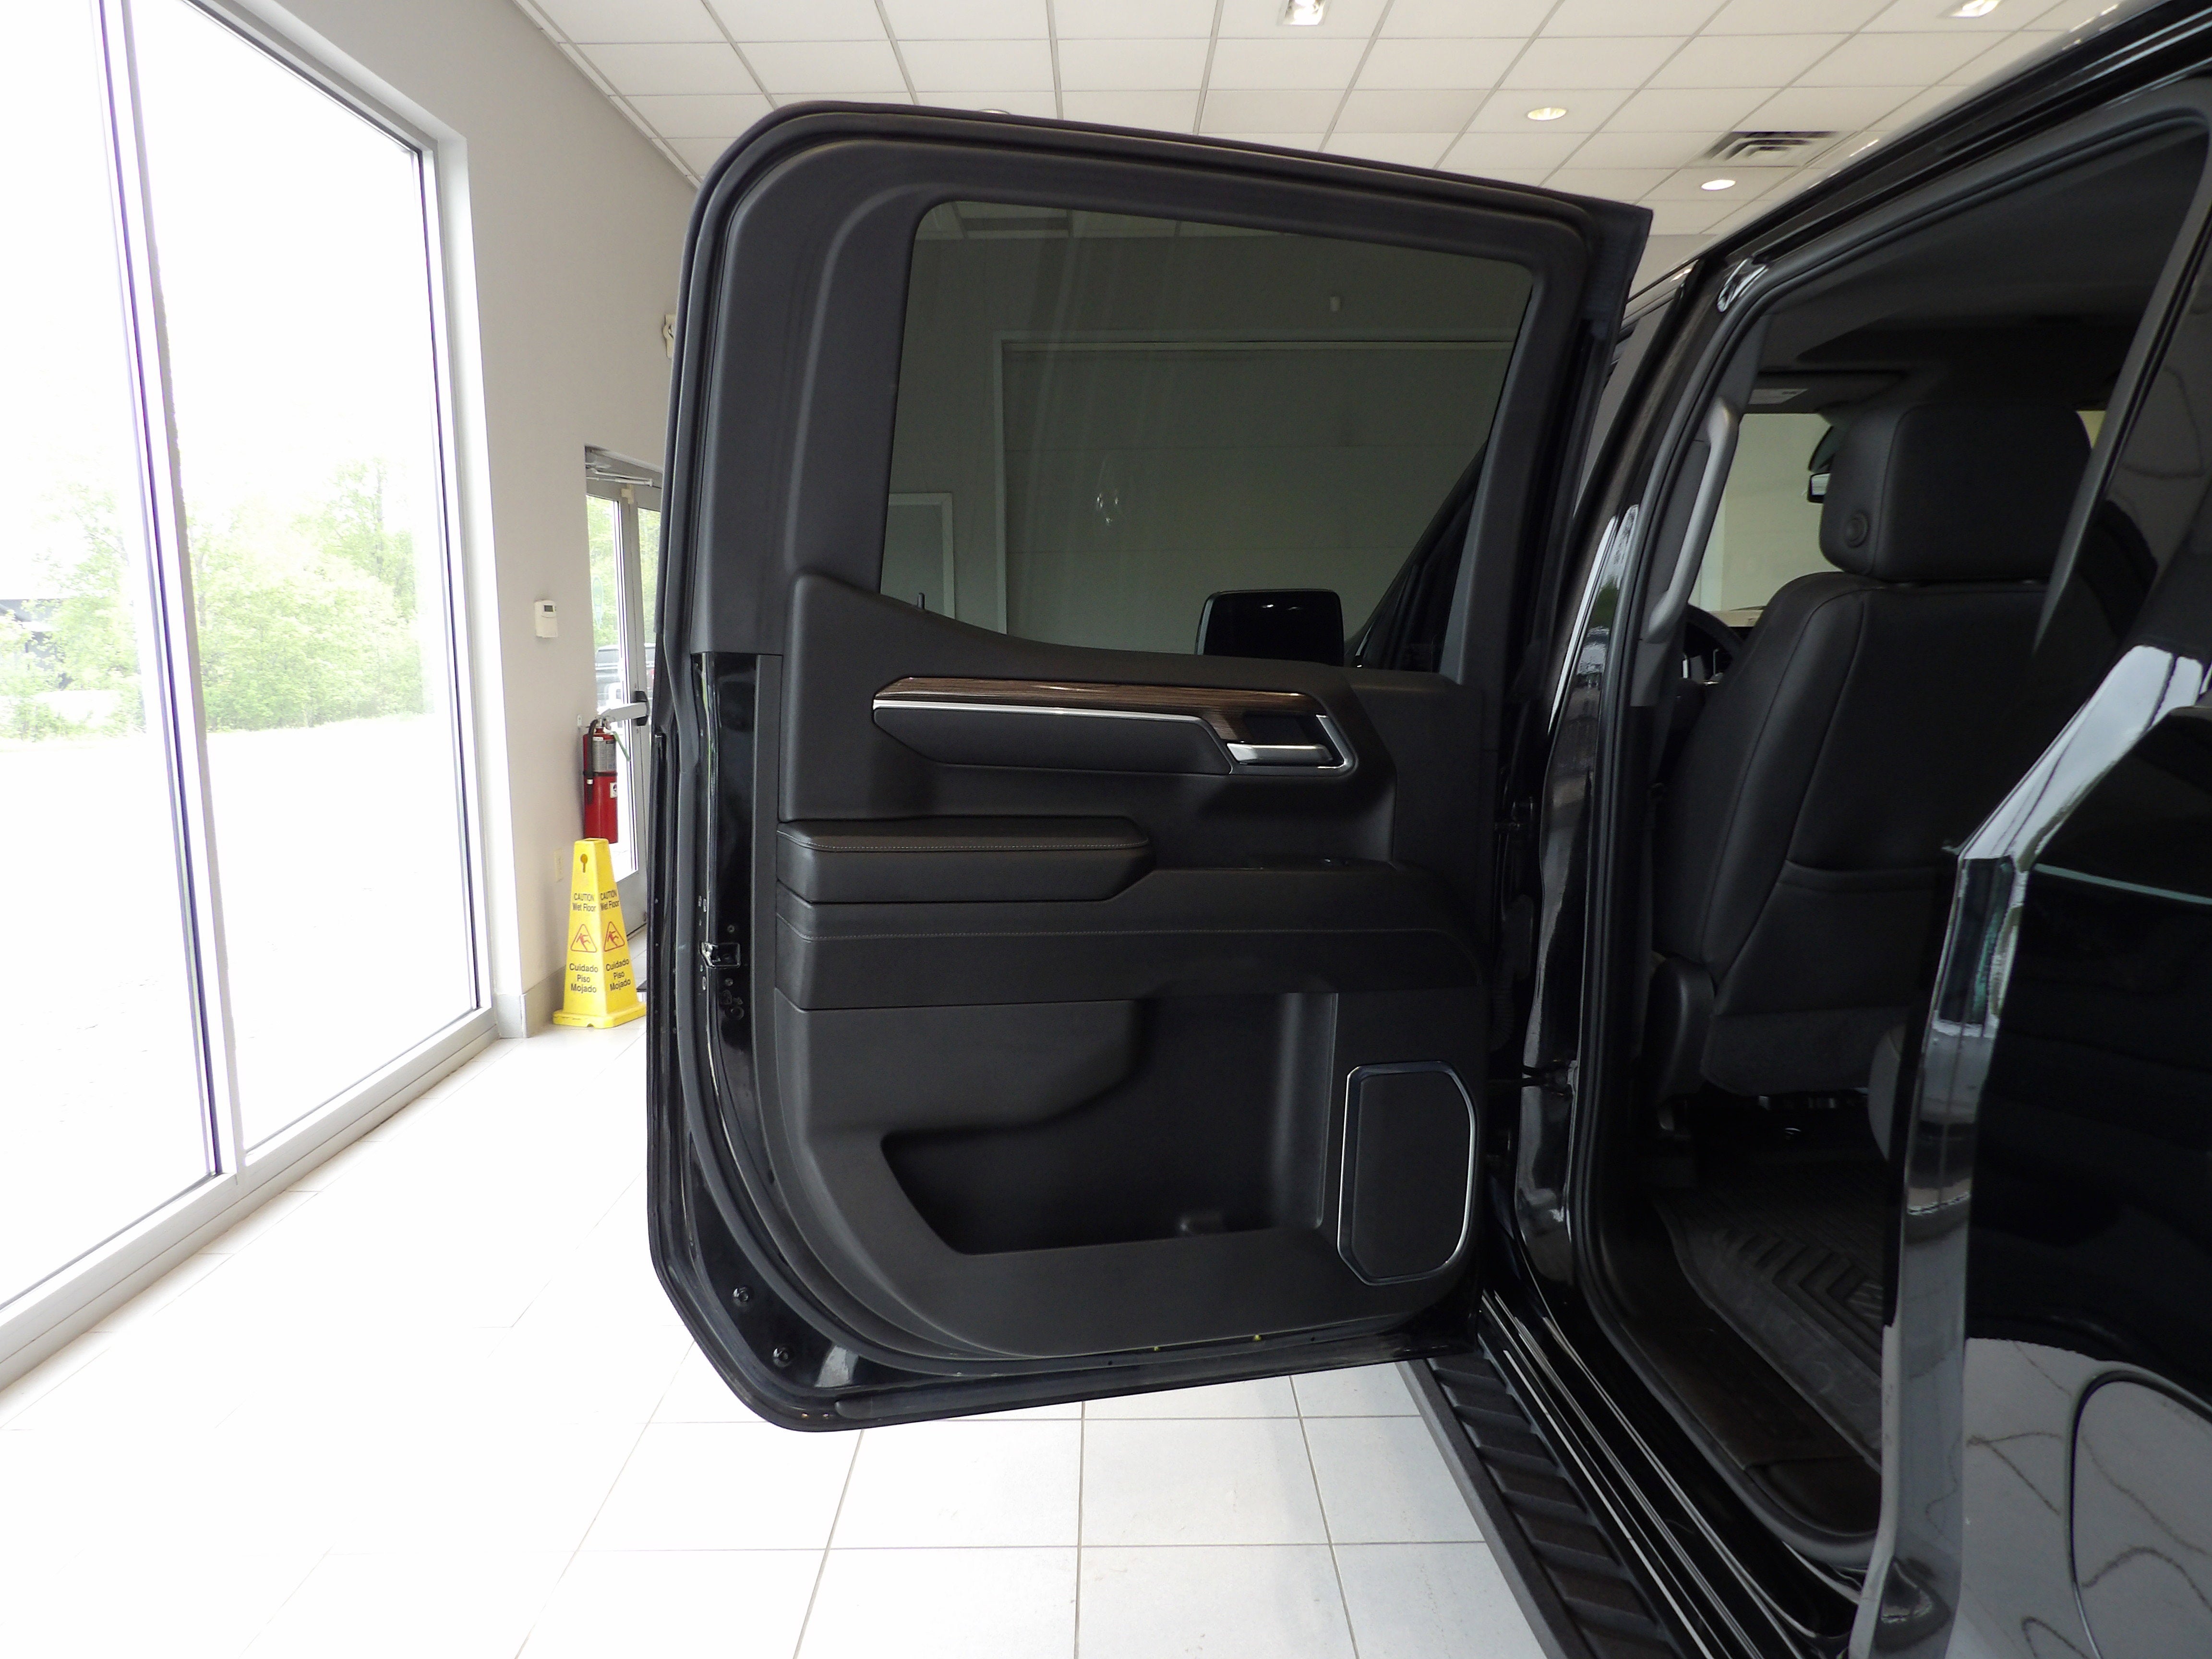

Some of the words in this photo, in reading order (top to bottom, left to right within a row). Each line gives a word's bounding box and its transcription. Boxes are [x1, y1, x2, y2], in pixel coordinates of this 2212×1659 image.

[574, 893, 594, 902] CAUTION
[600, 889, 617, 901] CAUTION
[572, 902, 582, 911] Wet
[583, 903, 596, 912] Floor
[600, 902, 608, 911] Wet
[608, 901, 619, 909] Floor
[569, 963, 598, 973] Cuidado
[606, 959, 629, 971] Cuidado
[577, 974, 590, 983] Piso
[613, 971, 625, 980] Piso
[571, 983, 597, 994] Mojado
[610, 978, 631, 991] Mojado
